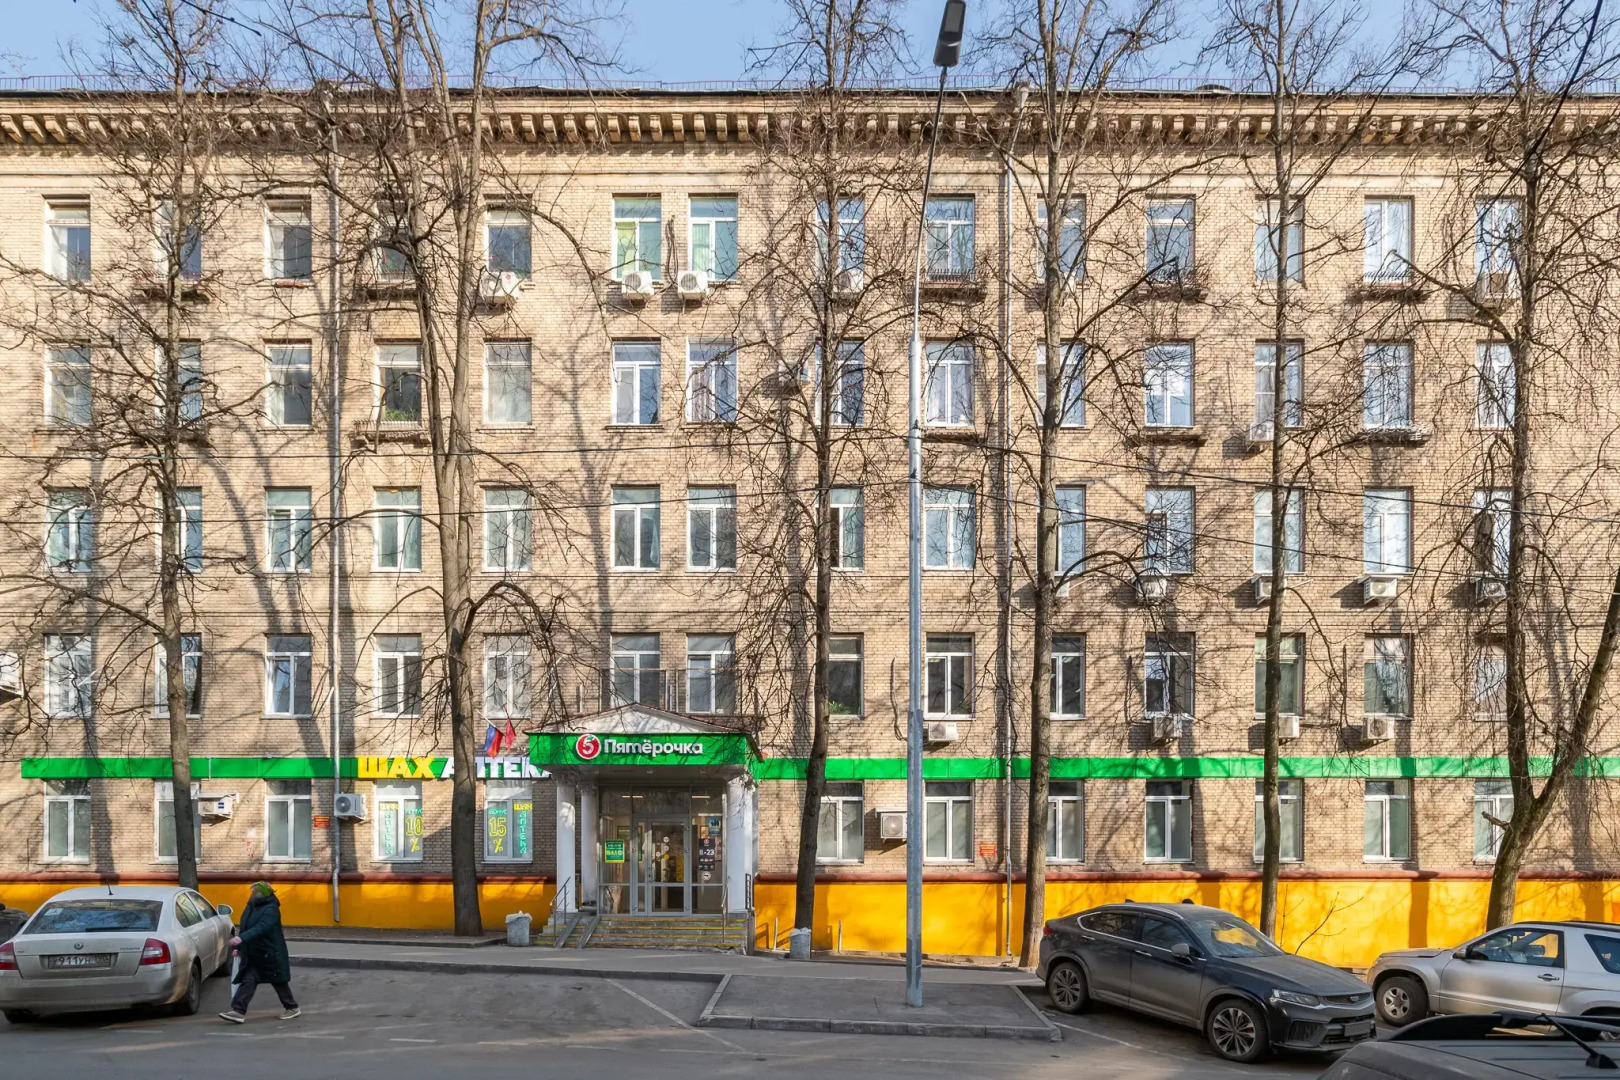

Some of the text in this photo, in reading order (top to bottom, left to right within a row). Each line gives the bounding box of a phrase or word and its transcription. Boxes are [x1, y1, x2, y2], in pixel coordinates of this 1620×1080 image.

[582, 736, 703, 757] 5 Пятёрочка
[358, 756, 435, 778] ШАХ
[405, 816, 423, 836] 10
[488, 817, 507, 837] 15
